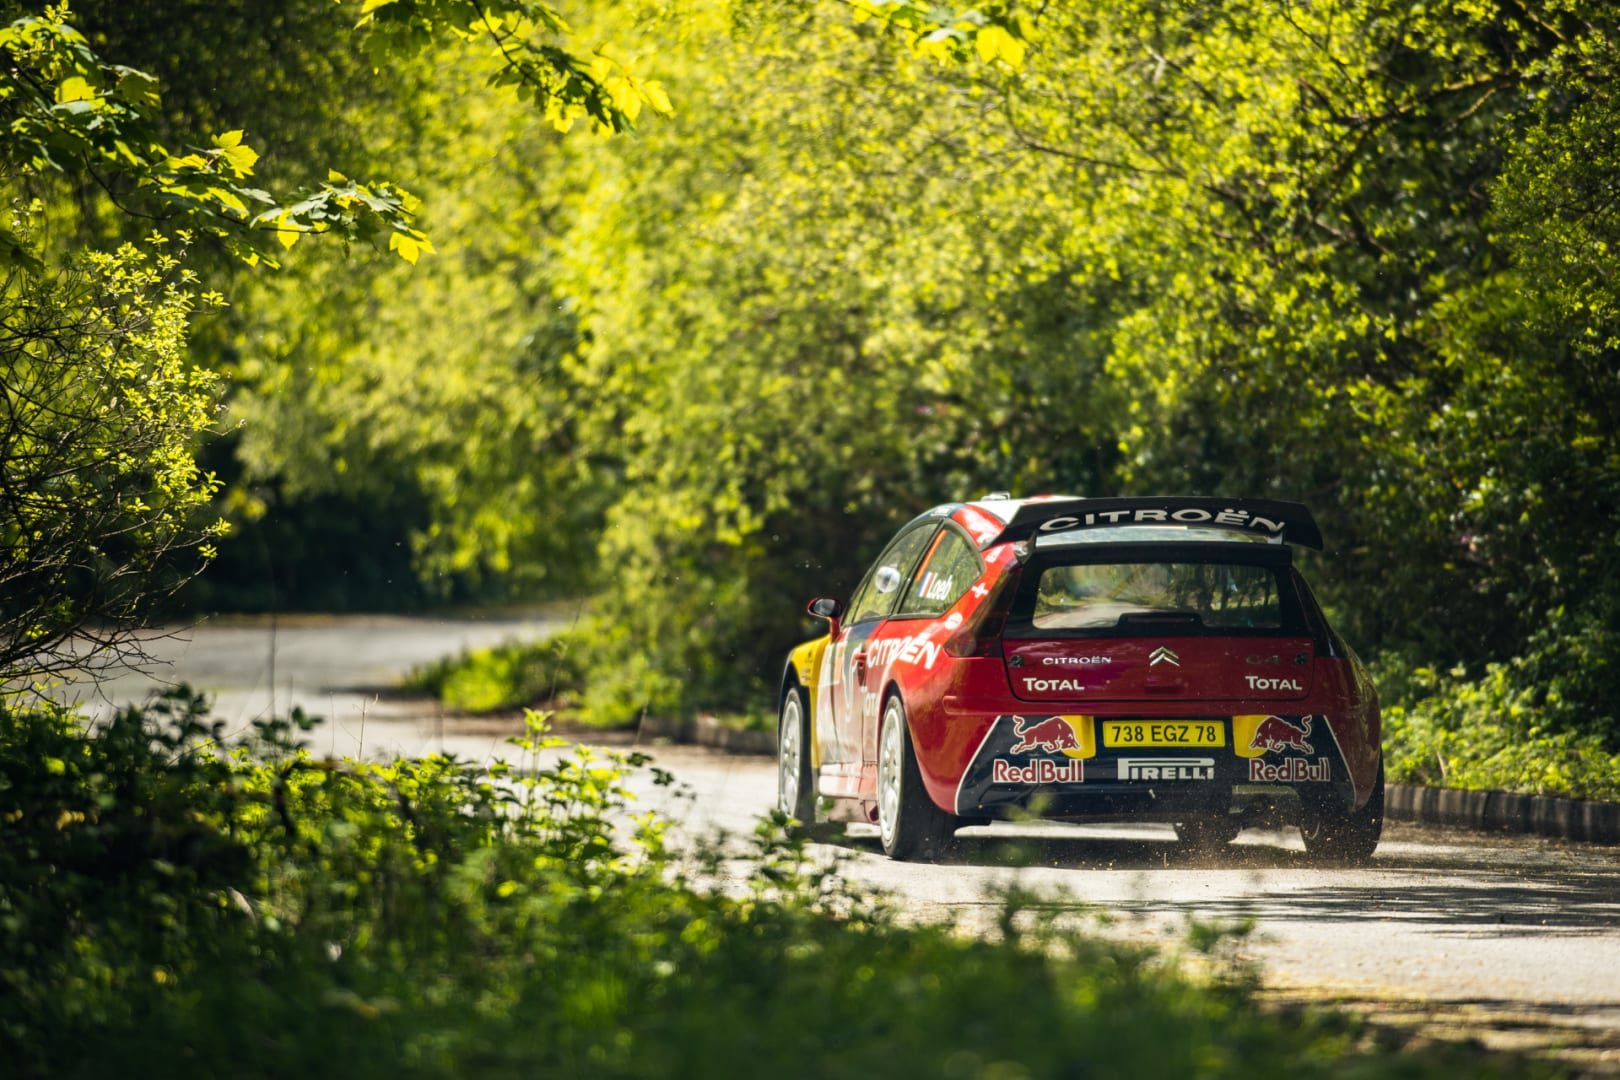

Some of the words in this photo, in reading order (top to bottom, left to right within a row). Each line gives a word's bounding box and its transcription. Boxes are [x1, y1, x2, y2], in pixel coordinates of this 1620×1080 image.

[1039, 508, 1286, 532] CITROËN
[1042, 656, 1112, 665] CITROËN
[1022, 677, 1085, 691] TOTAL
[1244, 676, 1303, 691] TOTAL
[1112, 725, 1144, 742] 738
[1151, 725, 1189, 742] EGZ
[1195, 725, 1216, 742] 78
[993, 759, 1038, 783] Red
[1039, 759, 1084, 783] Bull
[1117, 758, 1215, 780] PIRELLI
[1249, 758, 1292, 781] Red
[1293, 757, 1331, 781] Bull
